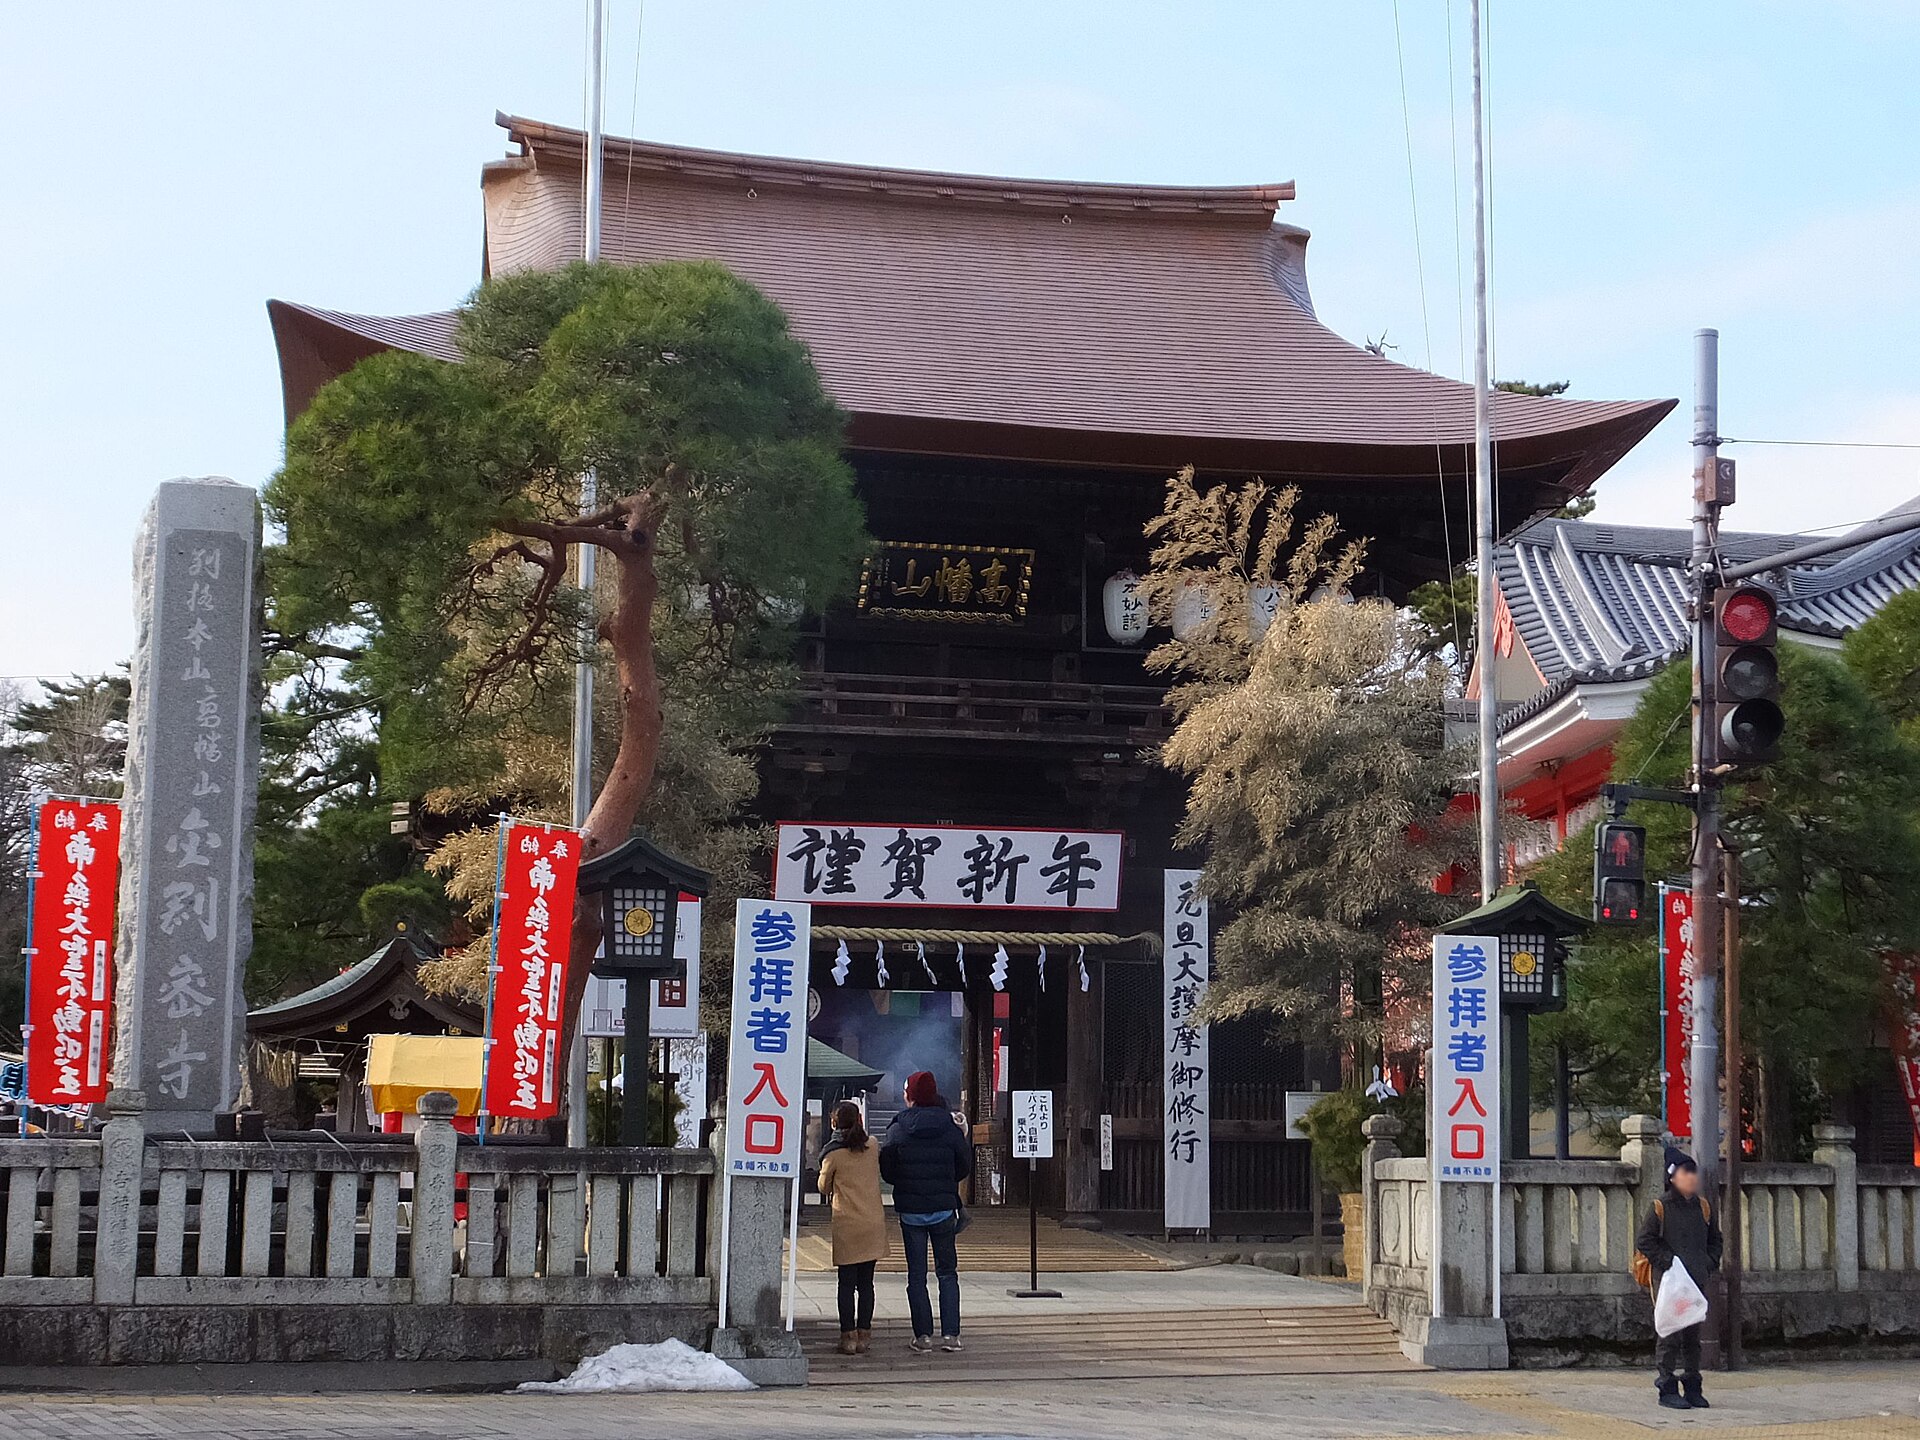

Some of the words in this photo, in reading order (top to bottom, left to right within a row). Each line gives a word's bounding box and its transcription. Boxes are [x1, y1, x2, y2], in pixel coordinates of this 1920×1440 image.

[54, 809, 109, 832] 奉納
[520, 835, 569, 859] 奉納
[787, 827, 1102, 906] 謹賀新年
[743, 909, 796, 1155] 参拝者入口
[1448, 943, 1487, 1160] 参拝者入口
[1039, 1095, 1048, 1130] これより
[733, 1160, 790, 1173] 高幡不動尊
[1442, 1166, 1492, 1176] 高幡不動尊
